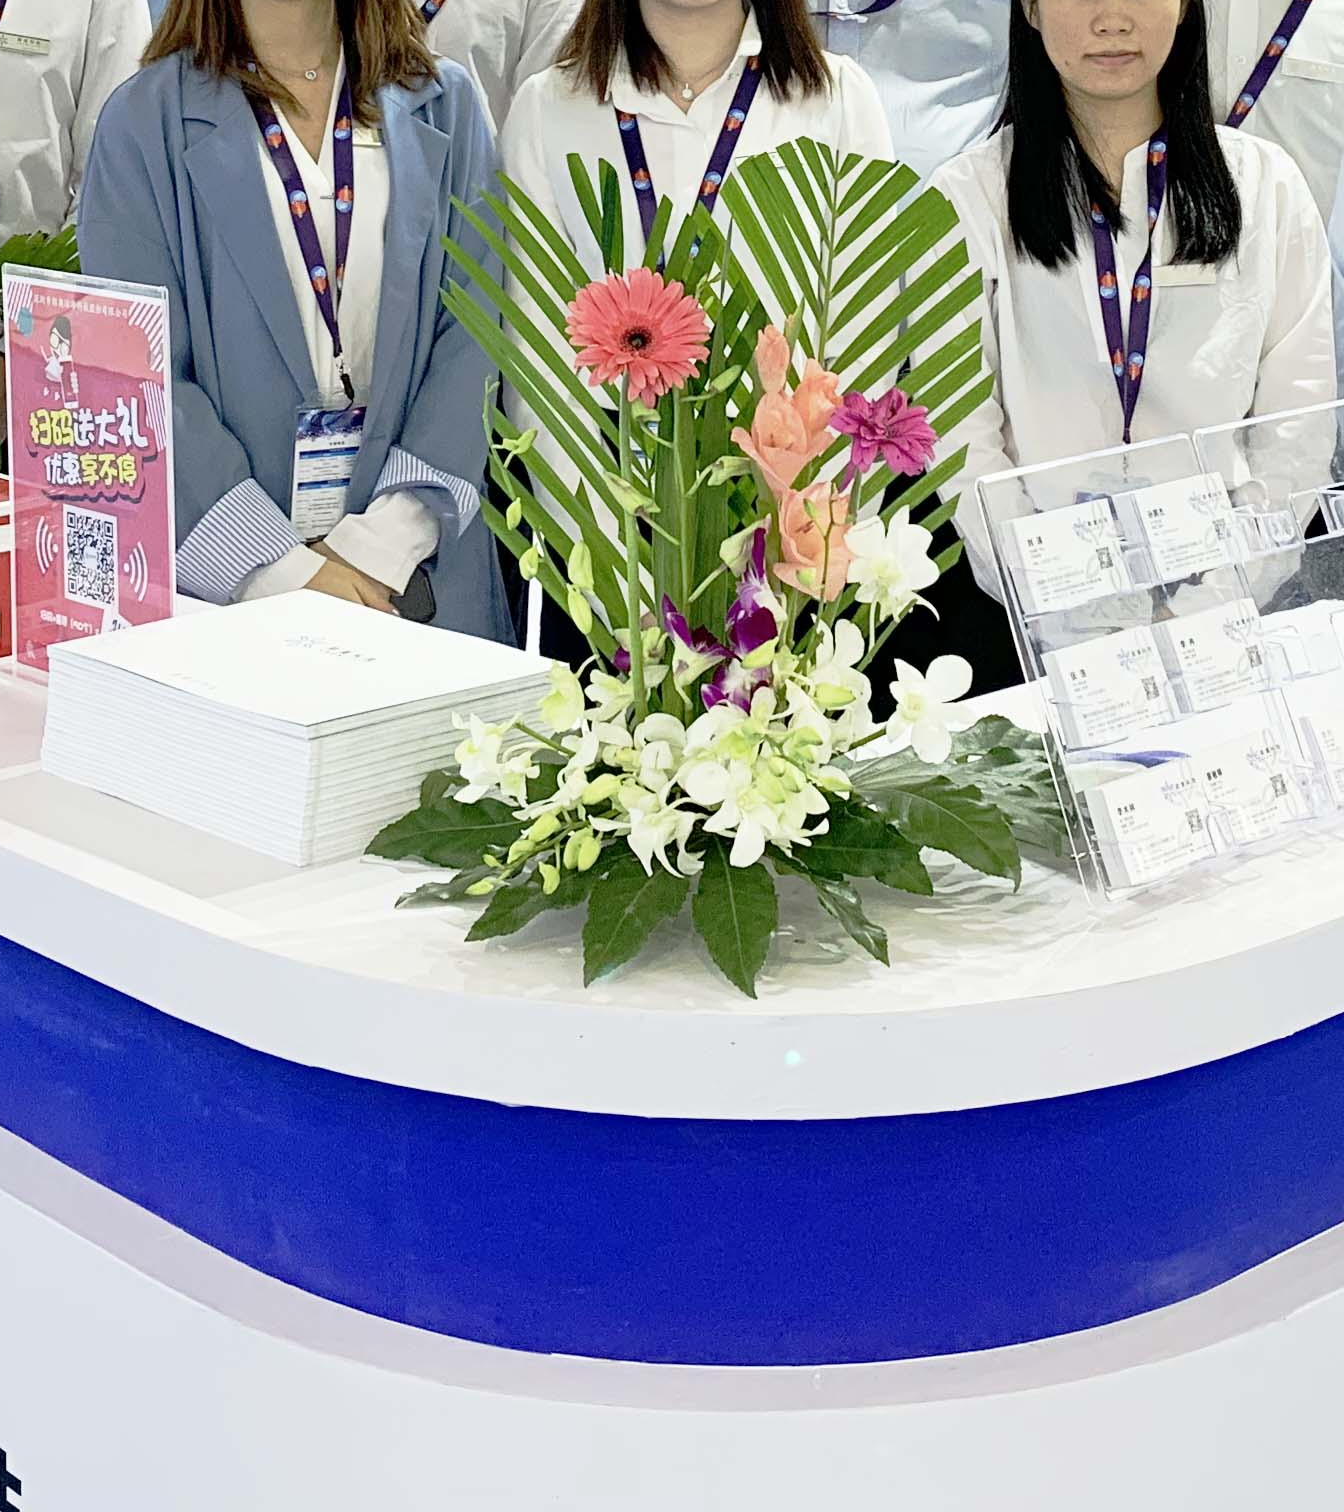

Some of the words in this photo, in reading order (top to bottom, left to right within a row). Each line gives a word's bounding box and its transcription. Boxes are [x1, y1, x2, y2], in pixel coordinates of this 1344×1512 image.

[29, 396, 149, 447] 扫码送大礼
[44, 452, 137, 487] 优惠享不停
